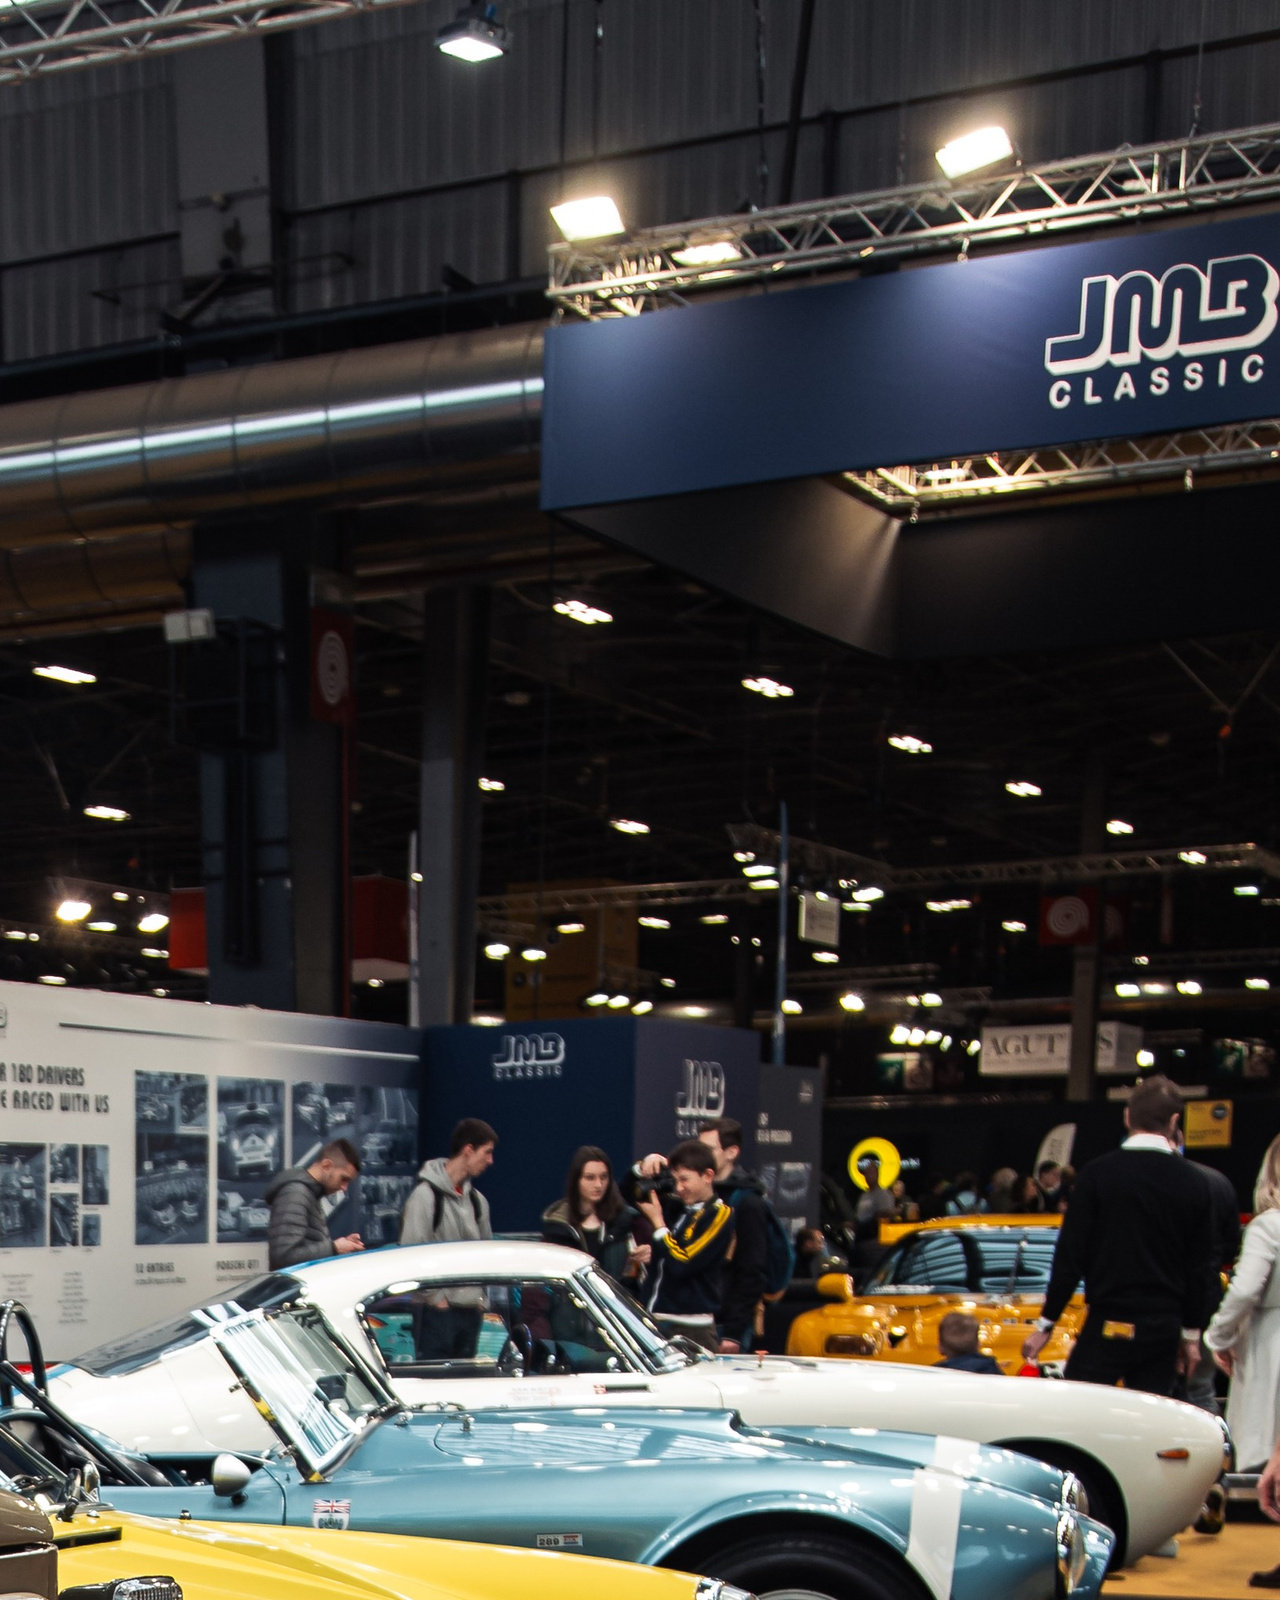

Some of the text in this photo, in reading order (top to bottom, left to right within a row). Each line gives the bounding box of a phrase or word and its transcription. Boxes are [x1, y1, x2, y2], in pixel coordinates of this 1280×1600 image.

[1045, 254, 1280, 376] JMB
[1049, 354, 1264, 409] CLASSIC
[492, 1032, 565, 1066] JMB
[11, 1062, 33, 1083] 180
[37, 1065, 85, 1087] DRIVERS
[495, 1064, 563, 1081] CLASSIC
[13, 1089, 54, 1111] RACED
[60, 1092, 90, 1113] WITH
[95, 1094, 110, 1114] US
